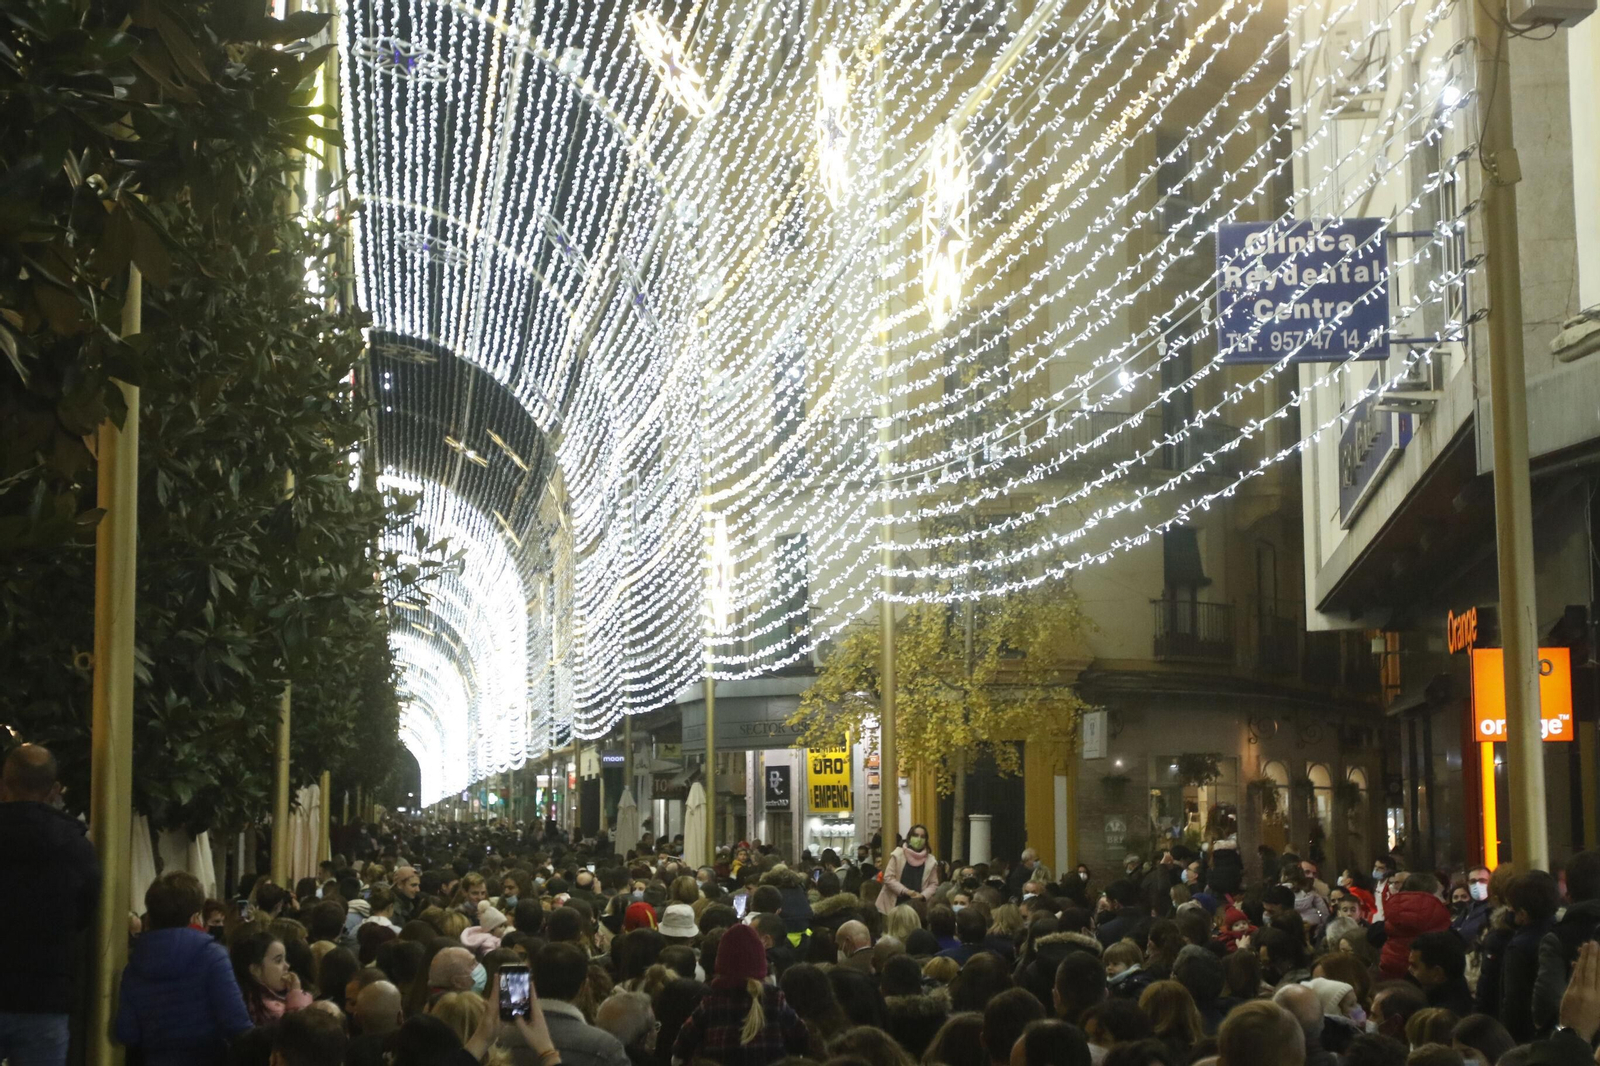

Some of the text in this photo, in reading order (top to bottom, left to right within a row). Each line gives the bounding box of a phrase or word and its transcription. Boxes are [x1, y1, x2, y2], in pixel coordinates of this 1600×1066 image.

[1225, 260, 1380, 290] Reydental
[1255, 299, 1353, 320] Centro
[1270, 331, 1302, 351] 957
[1312, 330, 1332, 349] 47
[1341, 329, 1359, 349] 14
[1448, 606, 1477, 655] Orange
[740, 722, 785, 735] SECTOR
[1480, 719, 1562, 739] orge
[813, 758, 843, 774] ORO
[814, 780, 849, 808] EMPEÑO
